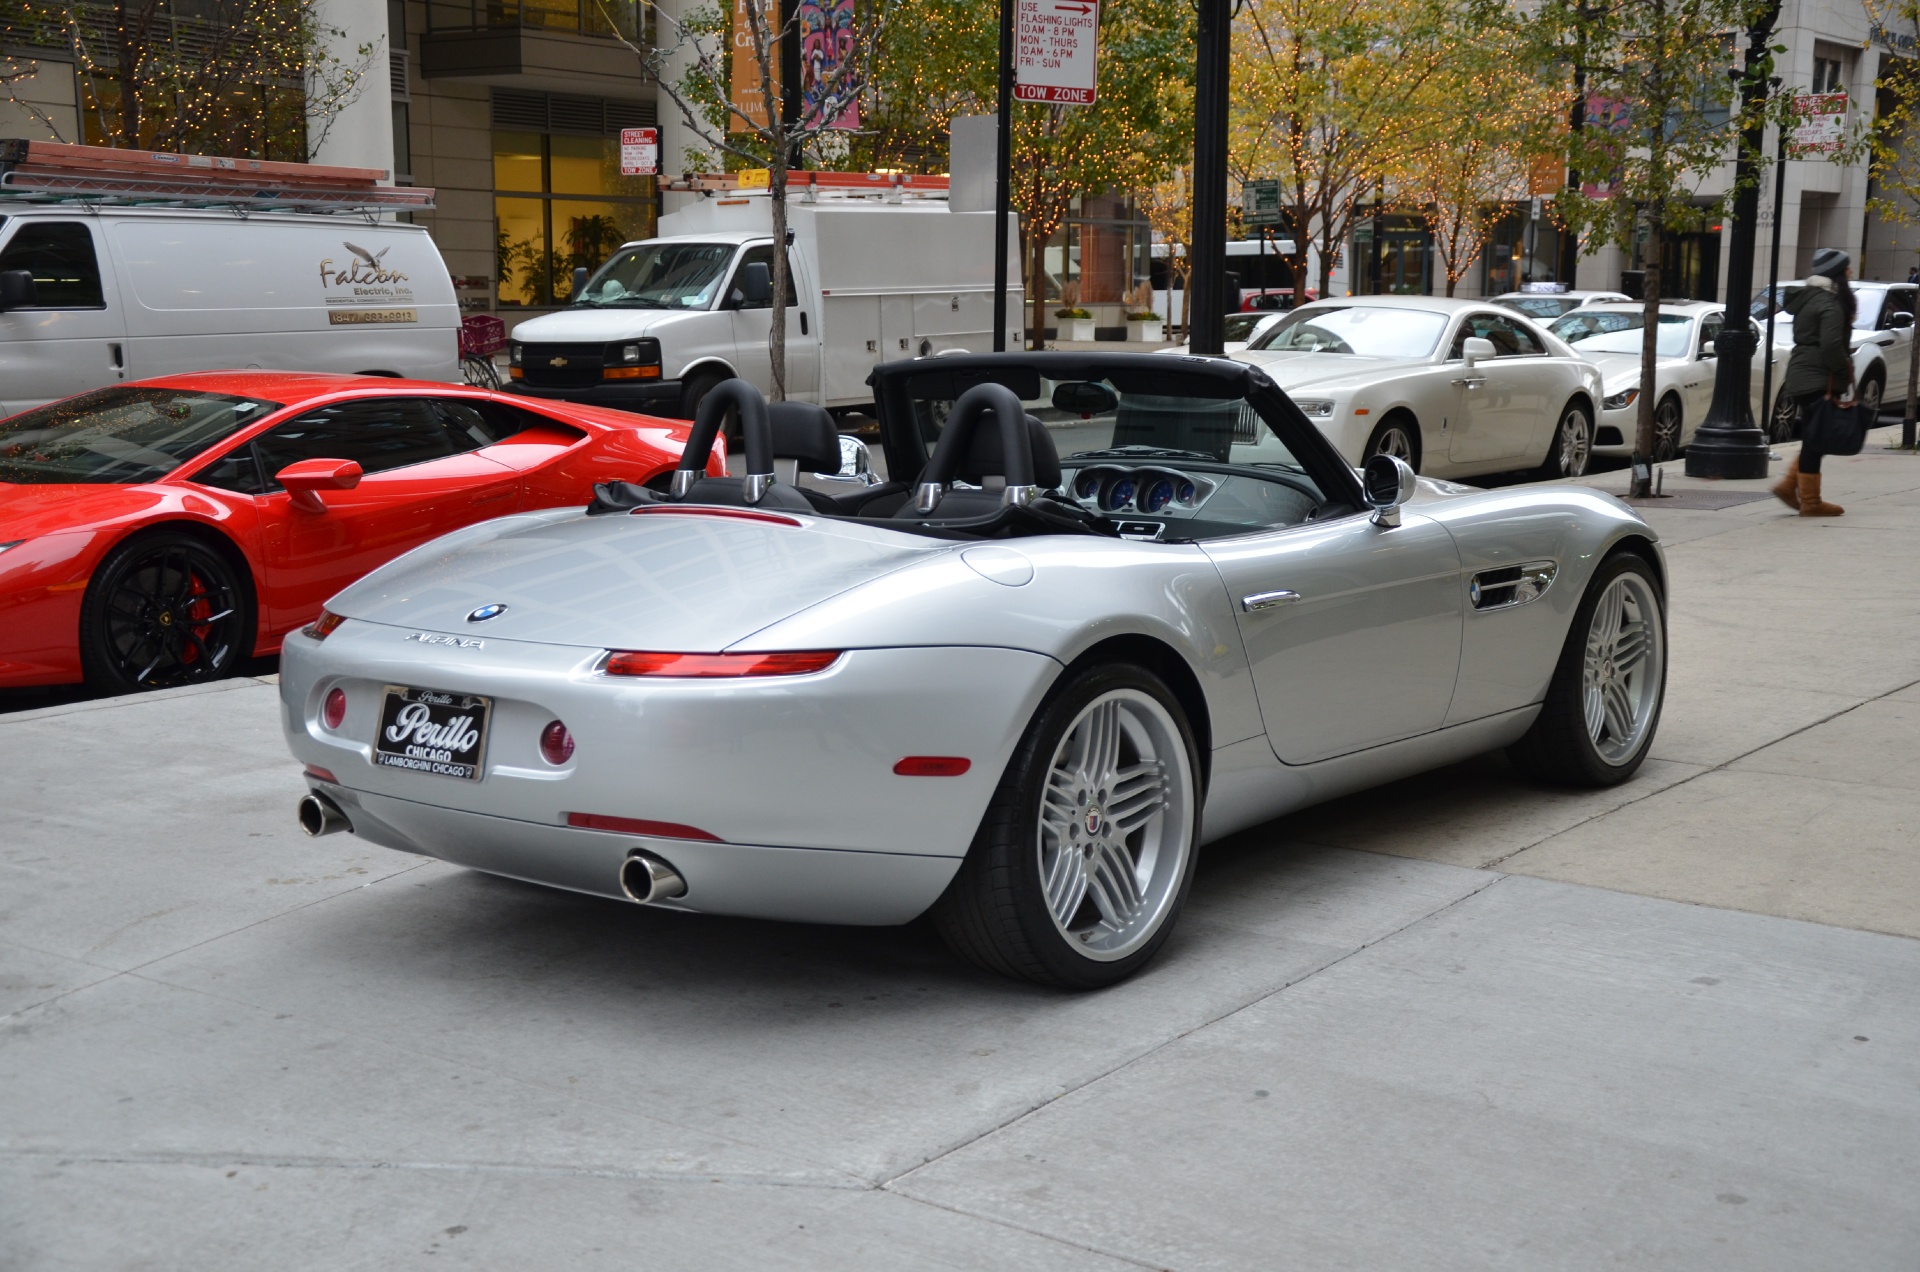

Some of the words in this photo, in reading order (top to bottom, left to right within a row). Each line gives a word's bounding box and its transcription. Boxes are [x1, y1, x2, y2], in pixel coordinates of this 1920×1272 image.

[1021, 2, 1038, 12] USE
[1021, 13, 1062, 25] FLASHING
[1064, 16, 1093, 28] LIGHTS
[1053, 26, 1059, 36] 8
[1062, 27, 1075, 37] PM
[1020, 35, 1040, 45] MON
[1049, 37, 1078, 48] THURS
[1052, 48, 1058, 58] 6
[1060, 49, 1073, 58] PM
[1020, 56, 1034, 66] FRI
[1042, 58, 1061, 68] SUN
[1020, 85, 1047, 99] TOW
[1053, 88, 1088, 102] ZONE
[320, 258, 408, 288] Falcon
[353, 287, 394, 296] Electric,
[404, 633, 485, 650] ALPINA
[417, 690, 453, 704] Perillo
[386, 702, 479, 753] Perillo
[405, 744, 452, 762] CHICAGO
[384, 755, 432, 772] LAMBORGHINI
[432, 763, 465, 777] CHICAGO
